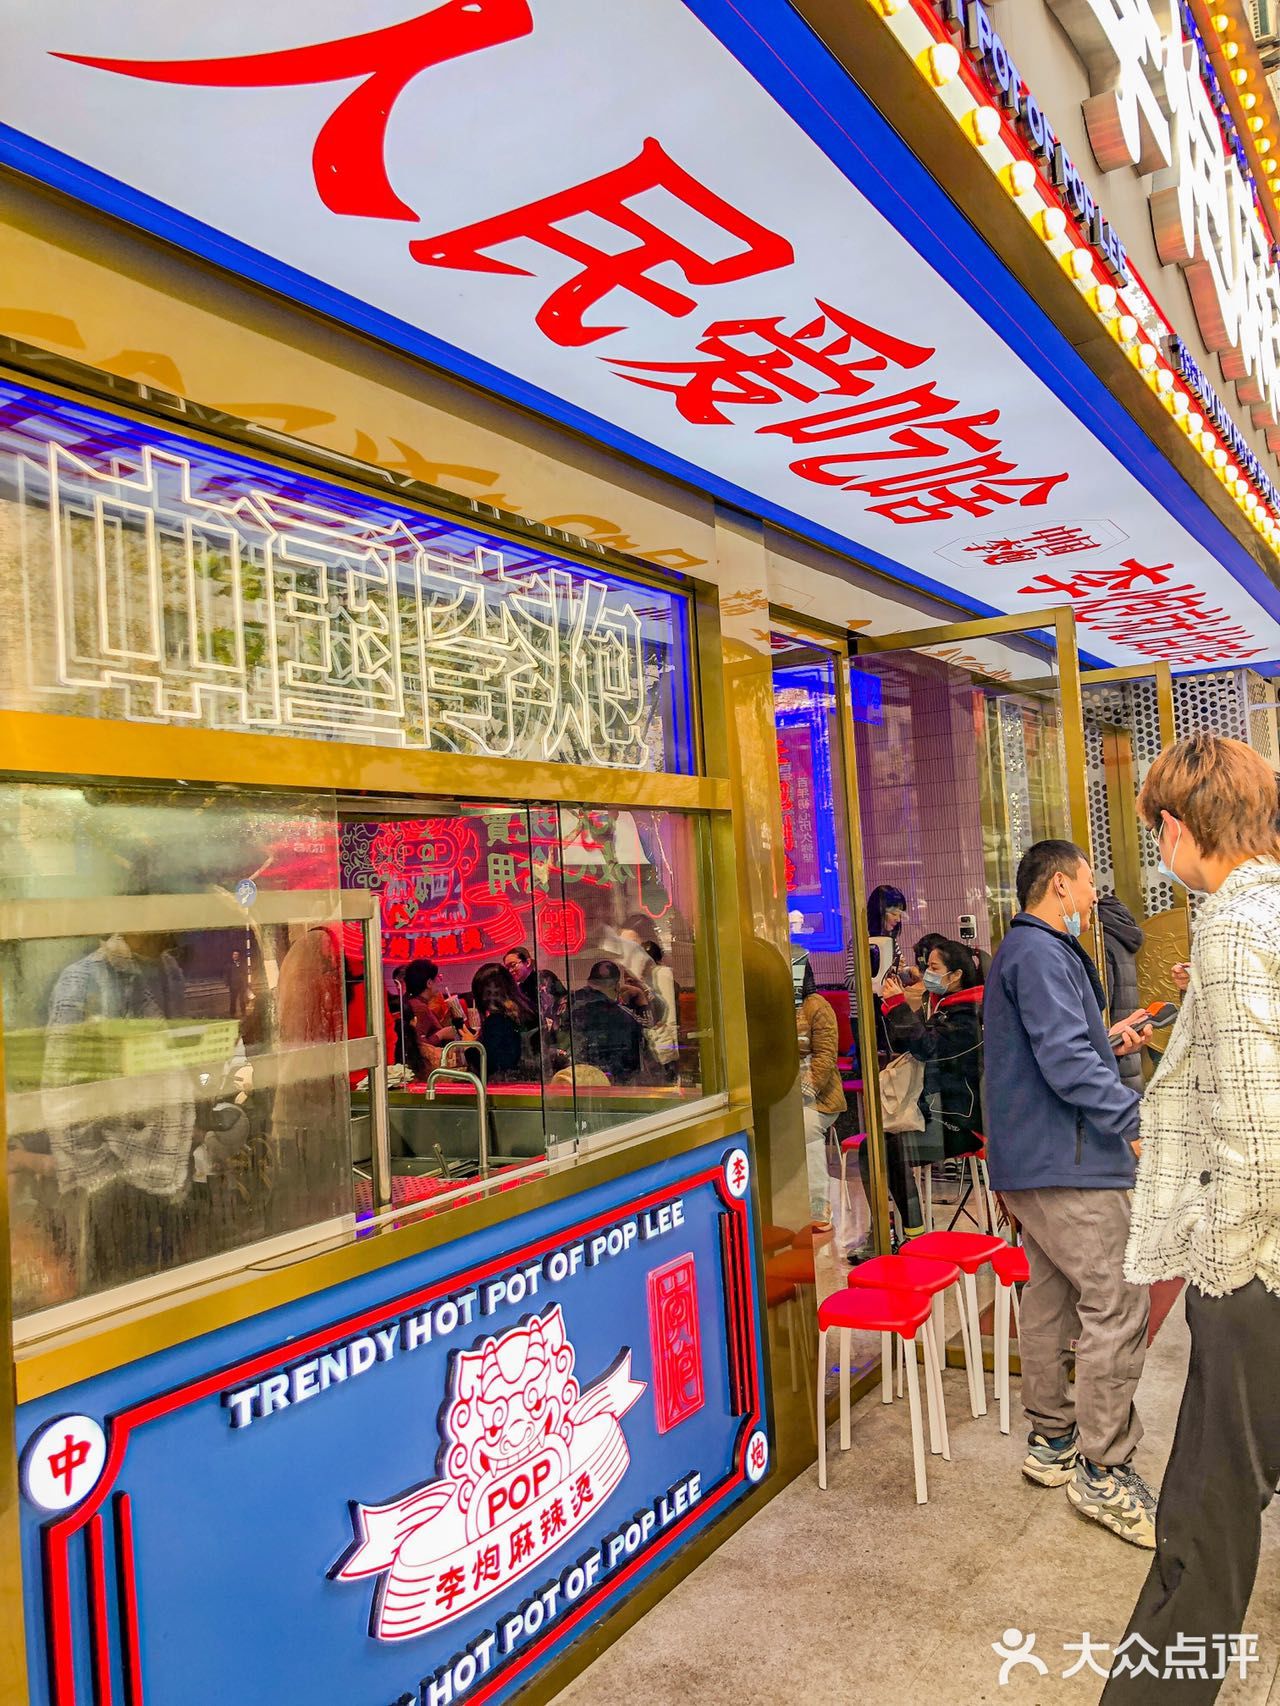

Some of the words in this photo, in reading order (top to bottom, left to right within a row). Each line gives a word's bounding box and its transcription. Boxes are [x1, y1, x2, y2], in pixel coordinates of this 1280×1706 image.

[975, 0, 1022, 114] POT
[1026, 95, 1056, 160] OF
[1060, 145, 1095, 221] POP
[47, 0, 1068, 524] 人民爱吃啥
[732, 1156, 746, 1190] 李
[229, 1325, 400, 1428] TRENDY
[405, 1295, 477, 1350] HOT
[486, 1266, 541, 1315] POT
[548, 1248, 584, 1282] OF
[592, 1221, 637, 1266] POP
[644, 1199, 685, 1239] LEE
[49, 1435, 91, 1496] 中
[488, 1459, 551, 1528] POP
[751, 1438, 766, 1470] 炮
[428, 1632, 496, 1706] HOT
[504, 1581, 561, 1653] POT
[566, 1552, 600, 1592] OF
[607, 1510, 656, 1569] POP
[660, 1473, 703, 1525] LEE
[435, 1471, 594, 1610] 李炮麻辣烫
